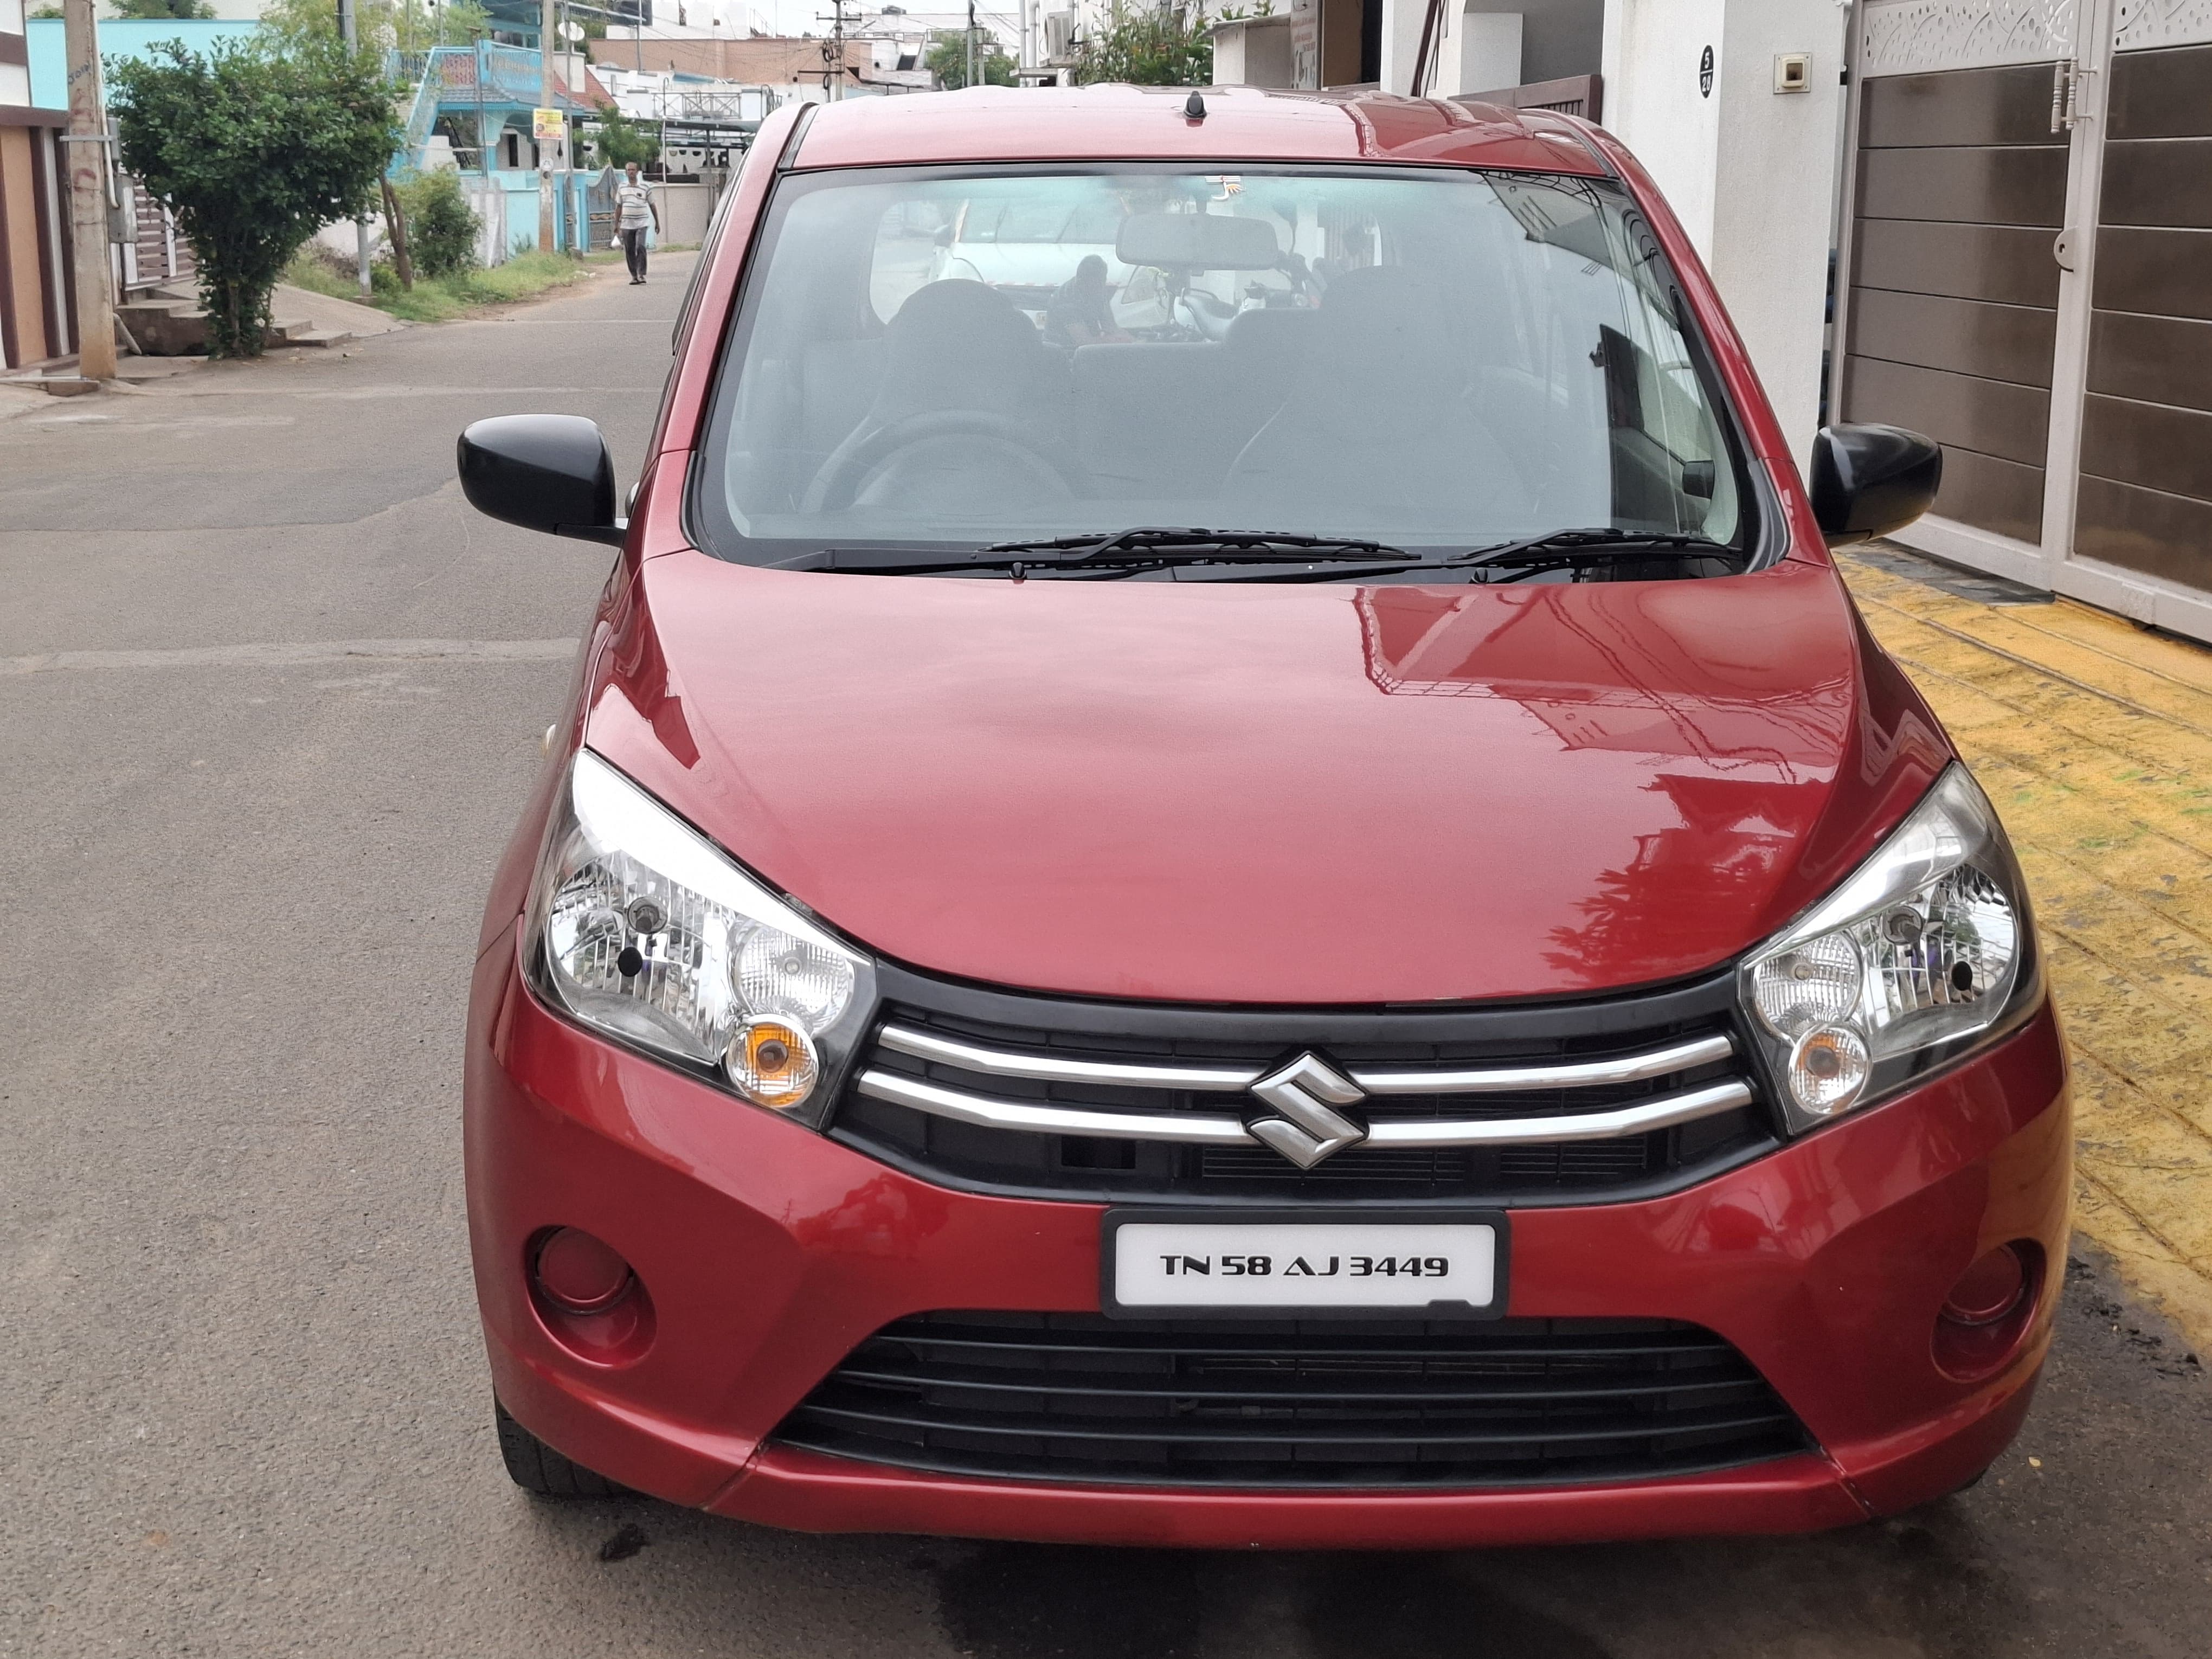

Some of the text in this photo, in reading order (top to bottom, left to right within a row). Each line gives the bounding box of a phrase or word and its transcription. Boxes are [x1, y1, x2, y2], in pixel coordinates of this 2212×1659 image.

[1704, 52, 1710, 69] 5
[1702, 75, 1711, 92] 28
[1160, 1255, 1449, 1277] TN 58 AJ 3449
